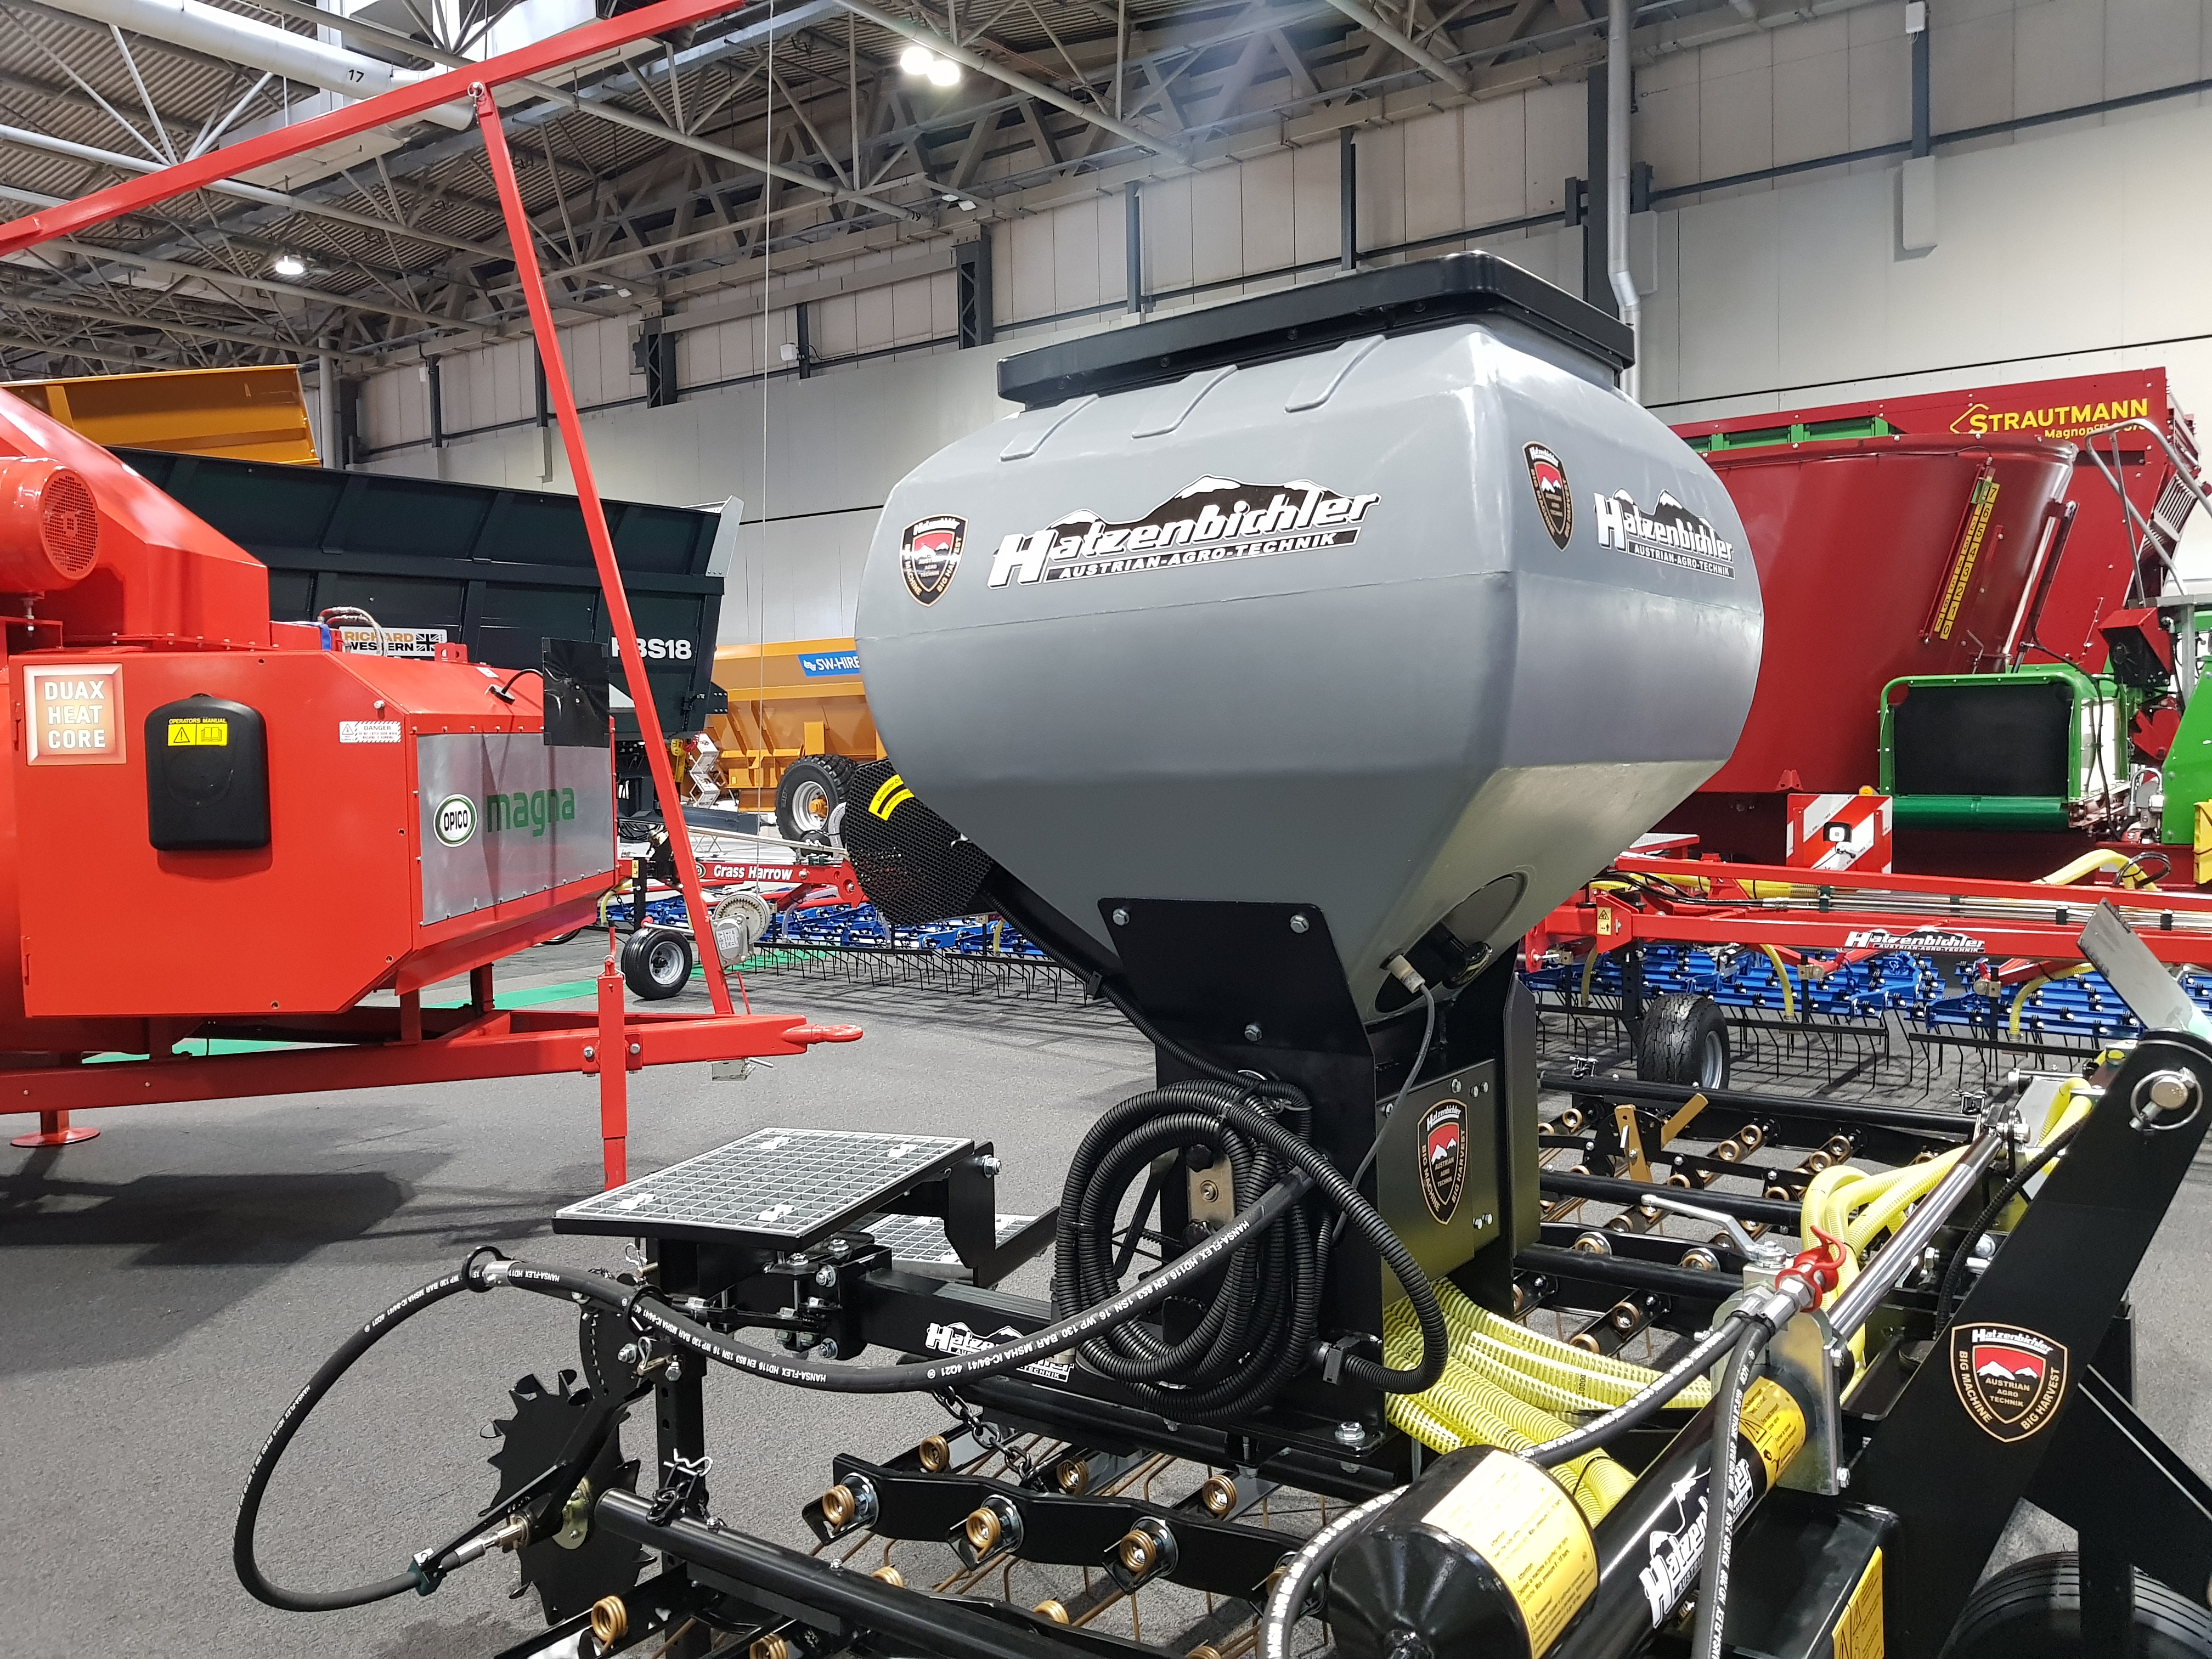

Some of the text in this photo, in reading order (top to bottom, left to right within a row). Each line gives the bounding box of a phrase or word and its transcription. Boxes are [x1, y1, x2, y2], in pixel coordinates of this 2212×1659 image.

[348, 69, 364, 82] 17
[1967, 398, 2147, 434] STRAUTMANN
[1594, 493, 1734, 563] Hatzenbichler
[988, 489, 1381, 589] Hatzenbichler
[1059, 533, 1338, 579] AUSTRIAN-AGRO-TECHNIK
[1634, 544, 1729, 576] AUSTRIAN-AGRO-TECHNIK
[349, 642, 414, 651] WESERN
[816, 656, 860, 670] SW-HIRE
[44, 680, 105, 701] DUAX
[48, 705, 103, 725] HEAT
[48, 729, 106, 749] CORE
[487, 787, 574, 837] magna
[443, 809, 468, 831] OPICO
[714, 865, 793, 880] Grass Harrow
[1844, 931, 1985, 948] Hatzenbichler
[1427, 1105, 1462, 1131] Hatzenbichler
[1435, 1156, 1454, 1171] AUSTRIAN
[1451, 1129, 1465, 1204] BIG HARVEST
[1440, 1168, 1450, 1177] AGRO
[1437, 1175, 1453, 1187] TECHNIK
[1424, 1169, 1441, 1213] MACHINE
[1199, 1220, 1250, 1260] HANSA-FLEX
[1170, 1258, 1198, 1279] HD116
[525, 1271, 560, 1283] HANSA-FLEX
[1153, 1277, 1169, 1290] EN
[426, 1282, 438, 1293] BAR
[1136, 1285, 1153, 1300] 853
[408, 1289, 425, 1302] MSHA
[1114, 1297, 1134, 1313] 1SN
[1099, 1309, 1111, 1320] 16
[662, 1320, 678, 1335] MSHA
[1080, 1316, 1097, 1330] WP
[678, 1329, 691, 1342] BAR
[1061, 1325, 1078, 1338] 130
[692, 1338, 702, 1347] 130
[702, 1343, 712, 1352] WP
[1036, 1333, 1058, 1348] BAR
[1972, 1329, 2053, 1355] Hatzenbichler
[713, 1346, 720, 1356] 16
[722, 1350, 733, 1361] 1SN
[1005, 1344, 1033, 1359] MSHA
[736, 1356, 747, 1365] 853
[747, 1358, 757, 1368] EN
[758, 1362, 779, 1374] HD116
[781, 1368, 827, 1383] HANSA-FLEX
[941, 1364, 963, 1376] 4Q21
[1959, 1350, 1993, 1423] BIG MACHINE
[1985, 1378, 2030, 1391] AUSTRIAN
[1989, 1395, 2024, 1407] TECHNIK
[1997, 1389, 2018, 1398] AGRO
[2021, 1367, 2060, 1430] BIG HARVEST
[1722, 1550, 1730, 1569] EN
[1731, 1415, 1740, 1441] MSHA
